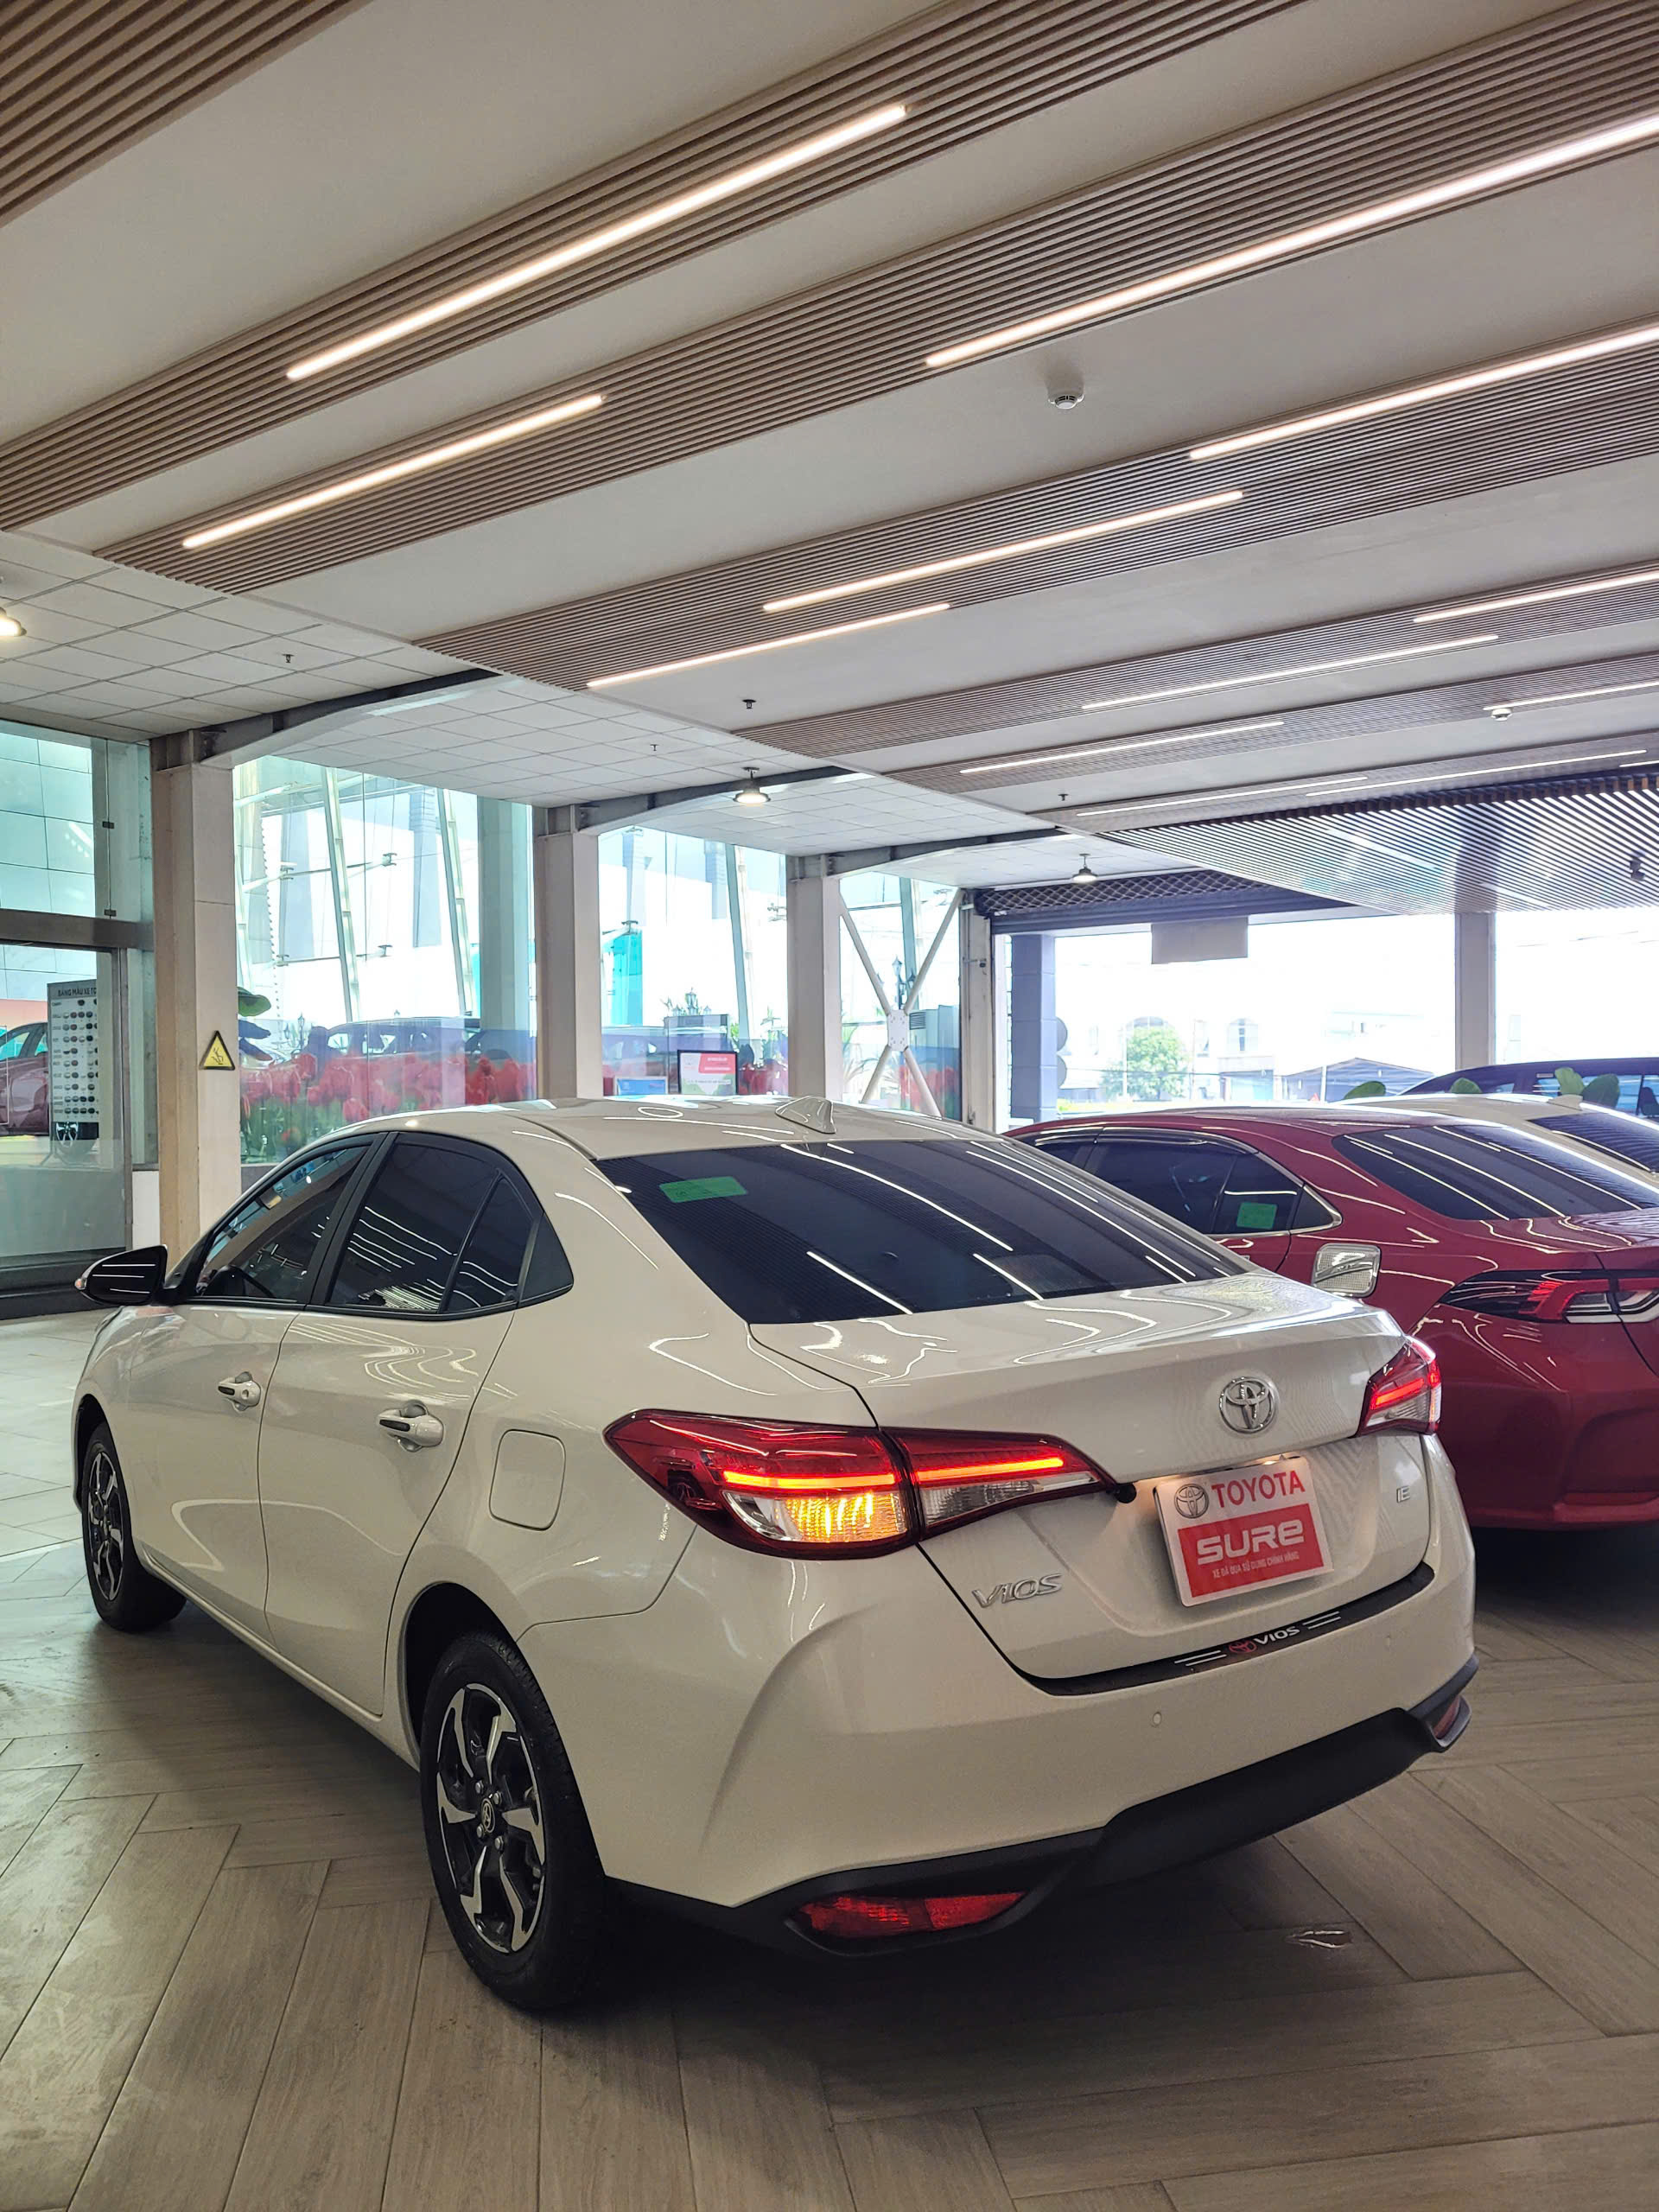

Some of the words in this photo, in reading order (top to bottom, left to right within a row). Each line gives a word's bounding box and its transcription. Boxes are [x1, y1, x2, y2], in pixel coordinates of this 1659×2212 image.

[1211, 1470, 1306, 1508] TOYOTA
[1212, 1569, 1221, 1579] XE
[971, 1573, 1063, 1609] VIOS
[1253, 1625, 1300, 1645] VIOS
